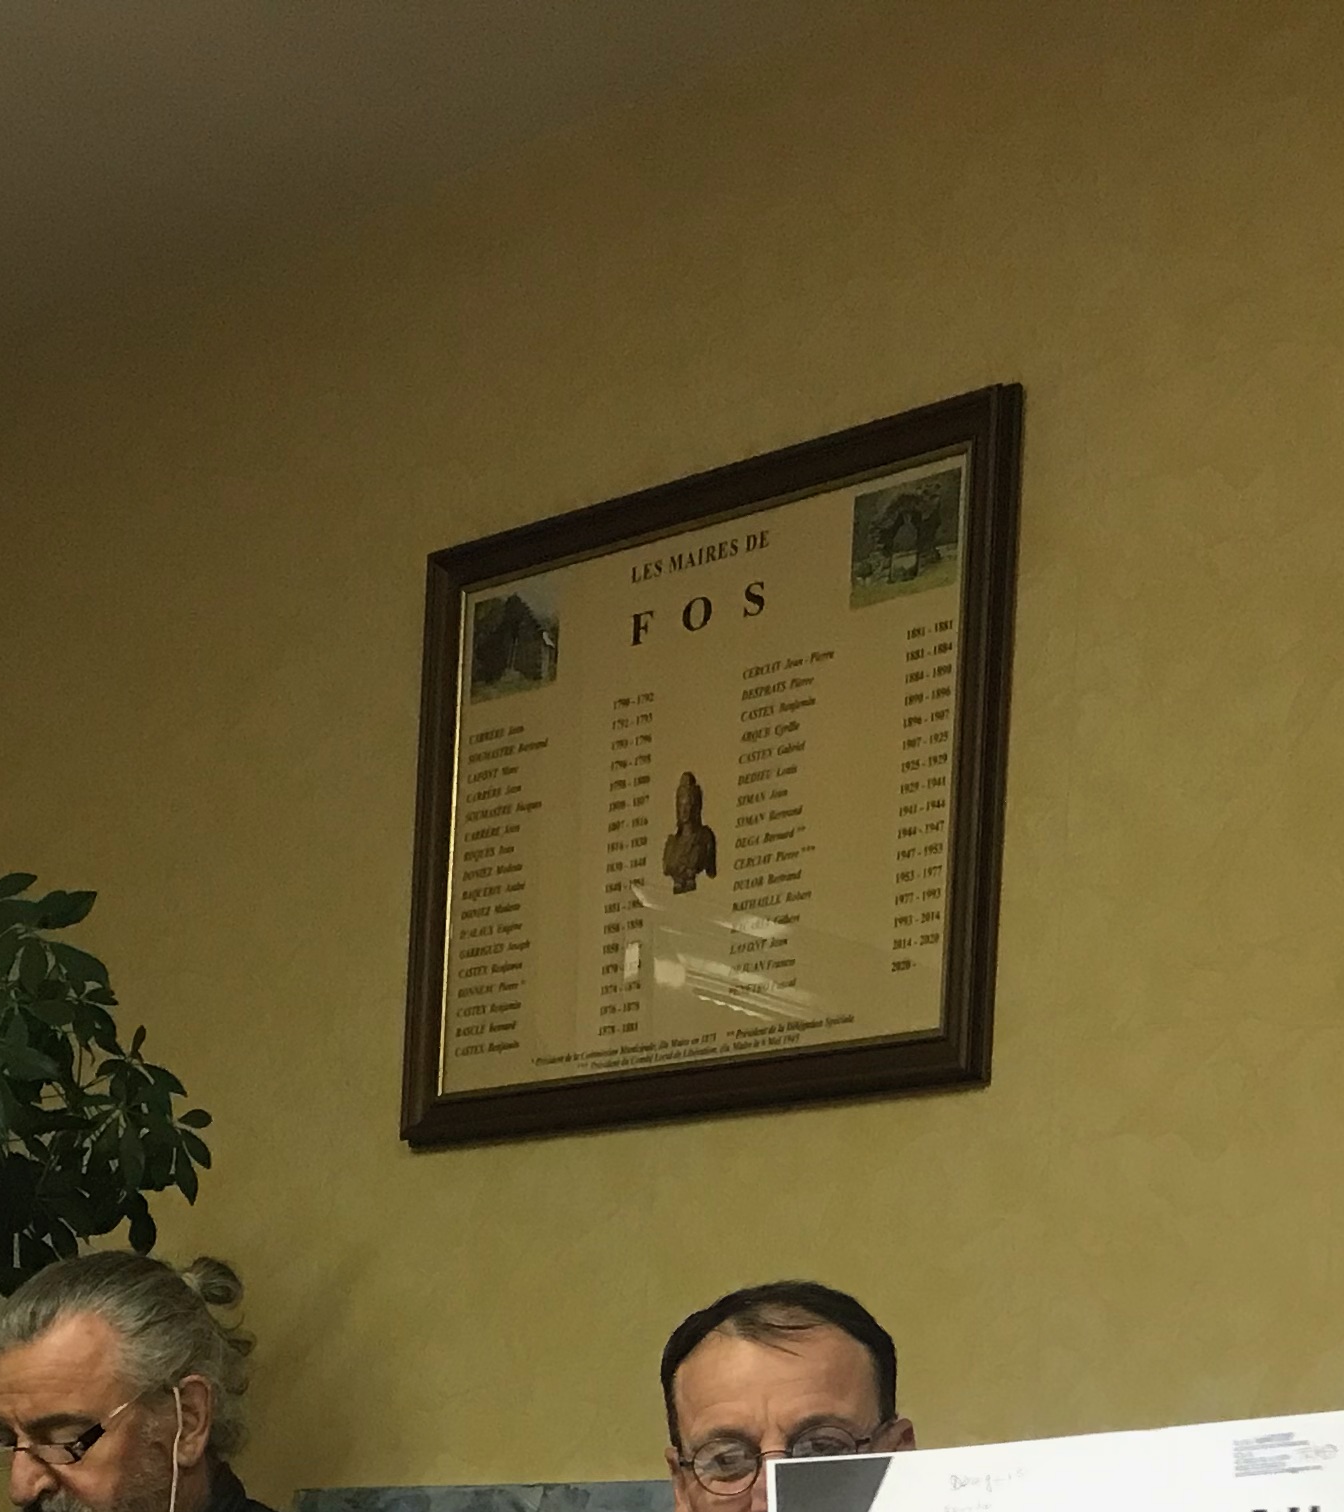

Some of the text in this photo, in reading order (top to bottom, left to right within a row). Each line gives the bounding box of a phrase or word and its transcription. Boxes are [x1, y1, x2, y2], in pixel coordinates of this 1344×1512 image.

[632, 530, 770, 584] LES MAIRES DE
[741, 704, 775, 722] CASTEX
[738, 747, 773, 765] CASTEX
[923, 865, 942, 879] 1977
[895, 892, 914, 906] 1977
